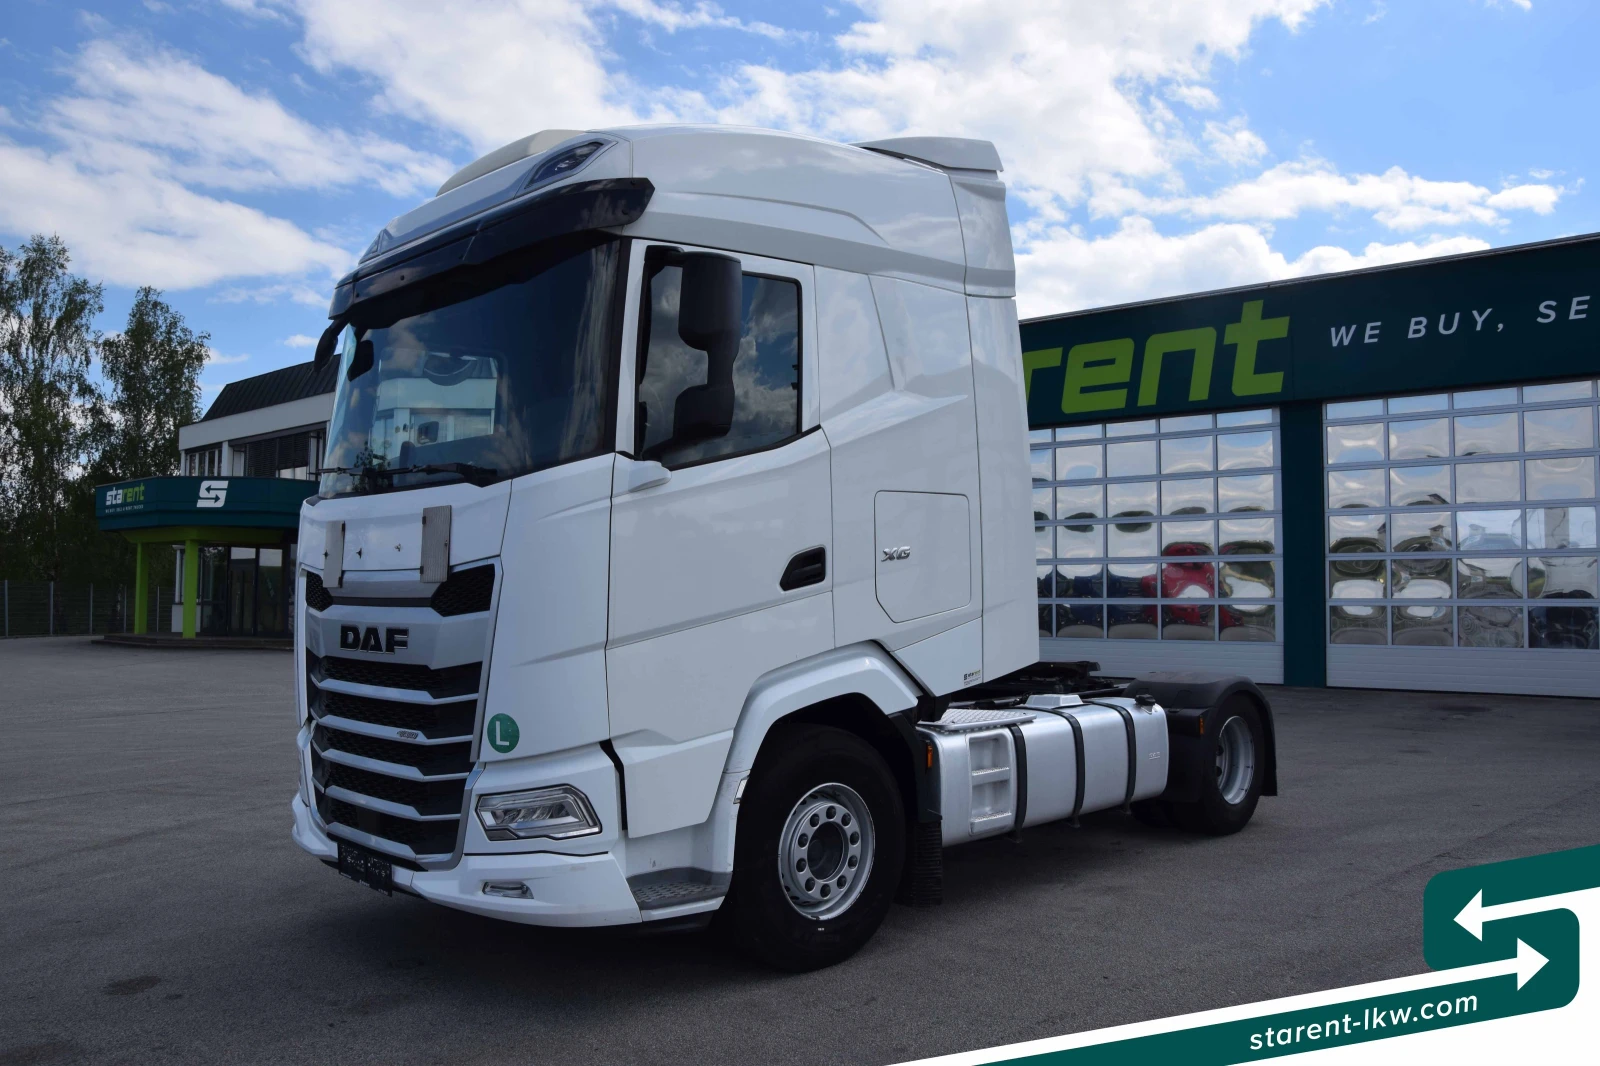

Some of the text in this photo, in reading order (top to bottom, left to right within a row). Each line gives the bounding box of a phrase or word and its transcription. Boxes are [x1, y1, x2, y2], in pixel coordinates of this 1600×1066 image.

[1330, 295, 1591, 347] WE BUY, SE
[105, 483, 145, 506] starent
[881, 546, 911, 562] XG
[340, 624, 409, 655] DAF
[495, 720, 510, 746] L
